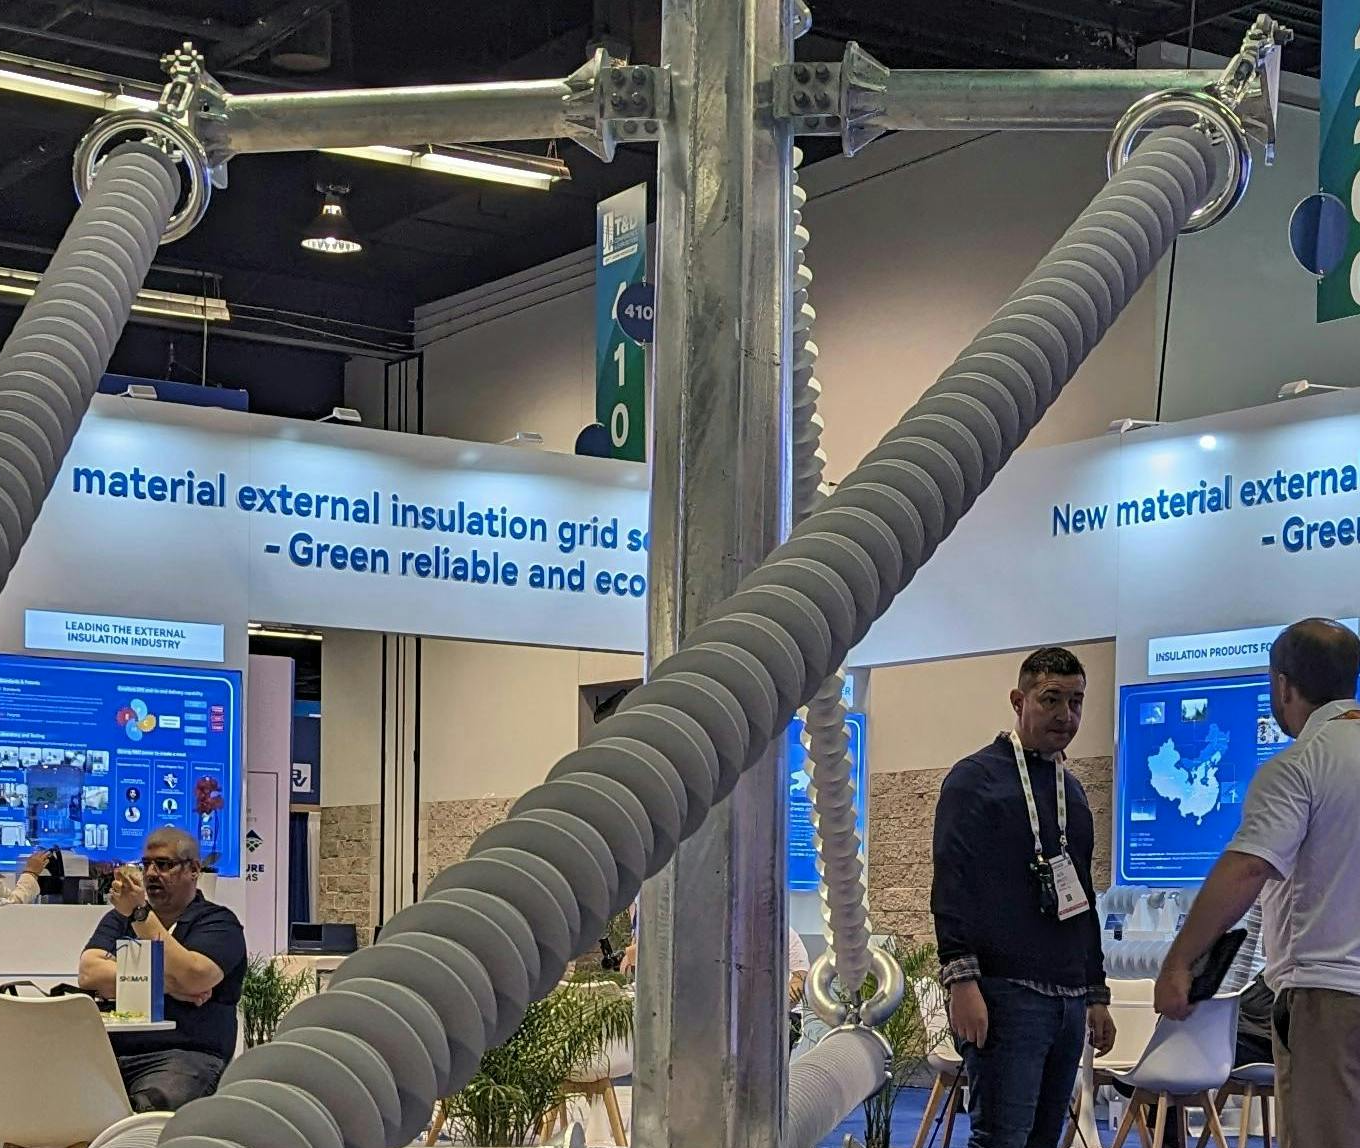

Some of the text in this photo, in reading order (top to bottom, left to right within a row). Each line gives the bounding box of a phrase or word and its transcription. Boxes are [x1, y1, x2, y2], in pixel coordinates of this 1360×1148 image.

[72, 466, 225, 507] material
[238, 485, 379, 524] external
[391, 493, 547, 542] insulation
[558, 516, 618, 553] grid
[1052, 504, 1108, 536] New
[1116, 475, 1232, 526] material
[288, 532, 389, 574] Green
[401, 545, 518, 586] reliable
[528, 560, 585, 592] and
[65, 621, 186, 639] LEADING THE EXTERNAL
[68, 632, 181, 650] INSULATION INDUSTRY
[1155, 648, 1208, 662] INSULATION
[1210, 643, 1258, 658] PRODUCTS
